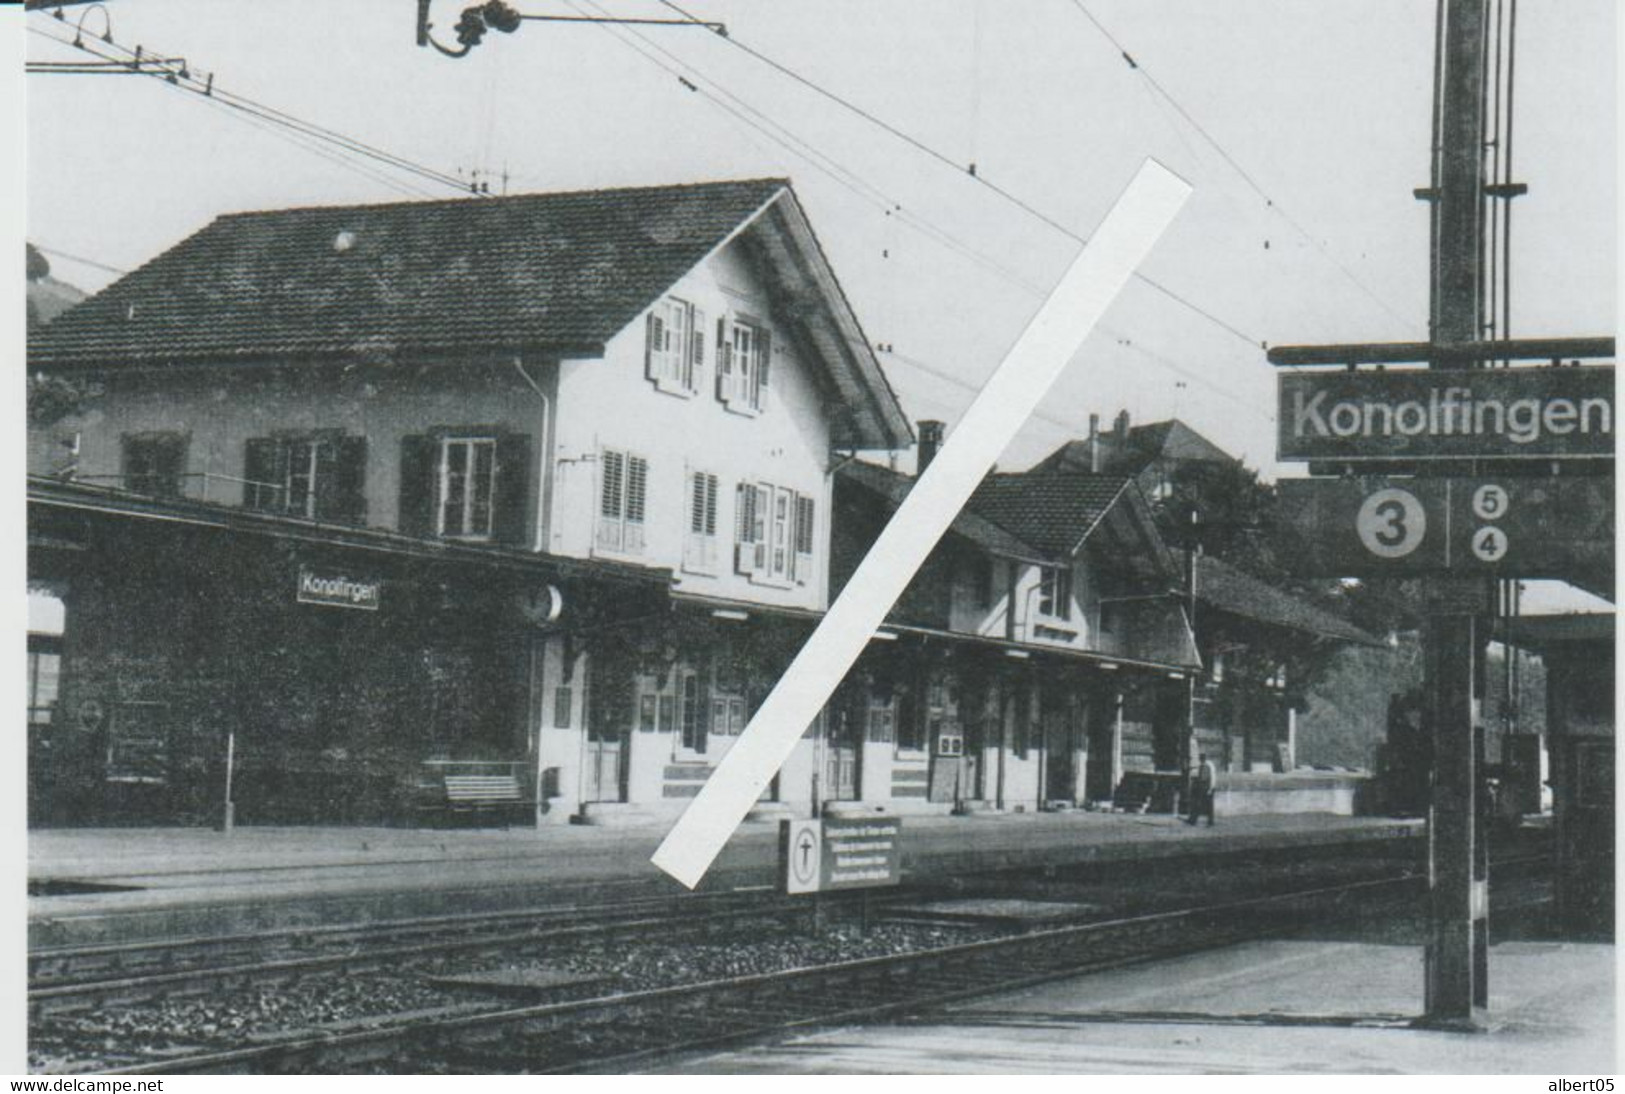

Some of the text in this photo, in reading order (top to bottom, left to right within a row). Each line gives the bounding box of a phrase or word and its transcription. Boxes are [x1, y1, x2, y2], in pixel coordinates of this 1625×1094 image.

[1293, 386, 1611, 444] Konolfingen
[1481, 490, 1498, 512] 5
[1374, 499, 1407, 547] 3
[1479, 533, 1498, 556] 4
[302, 572, 377, 603] Konolfingen
